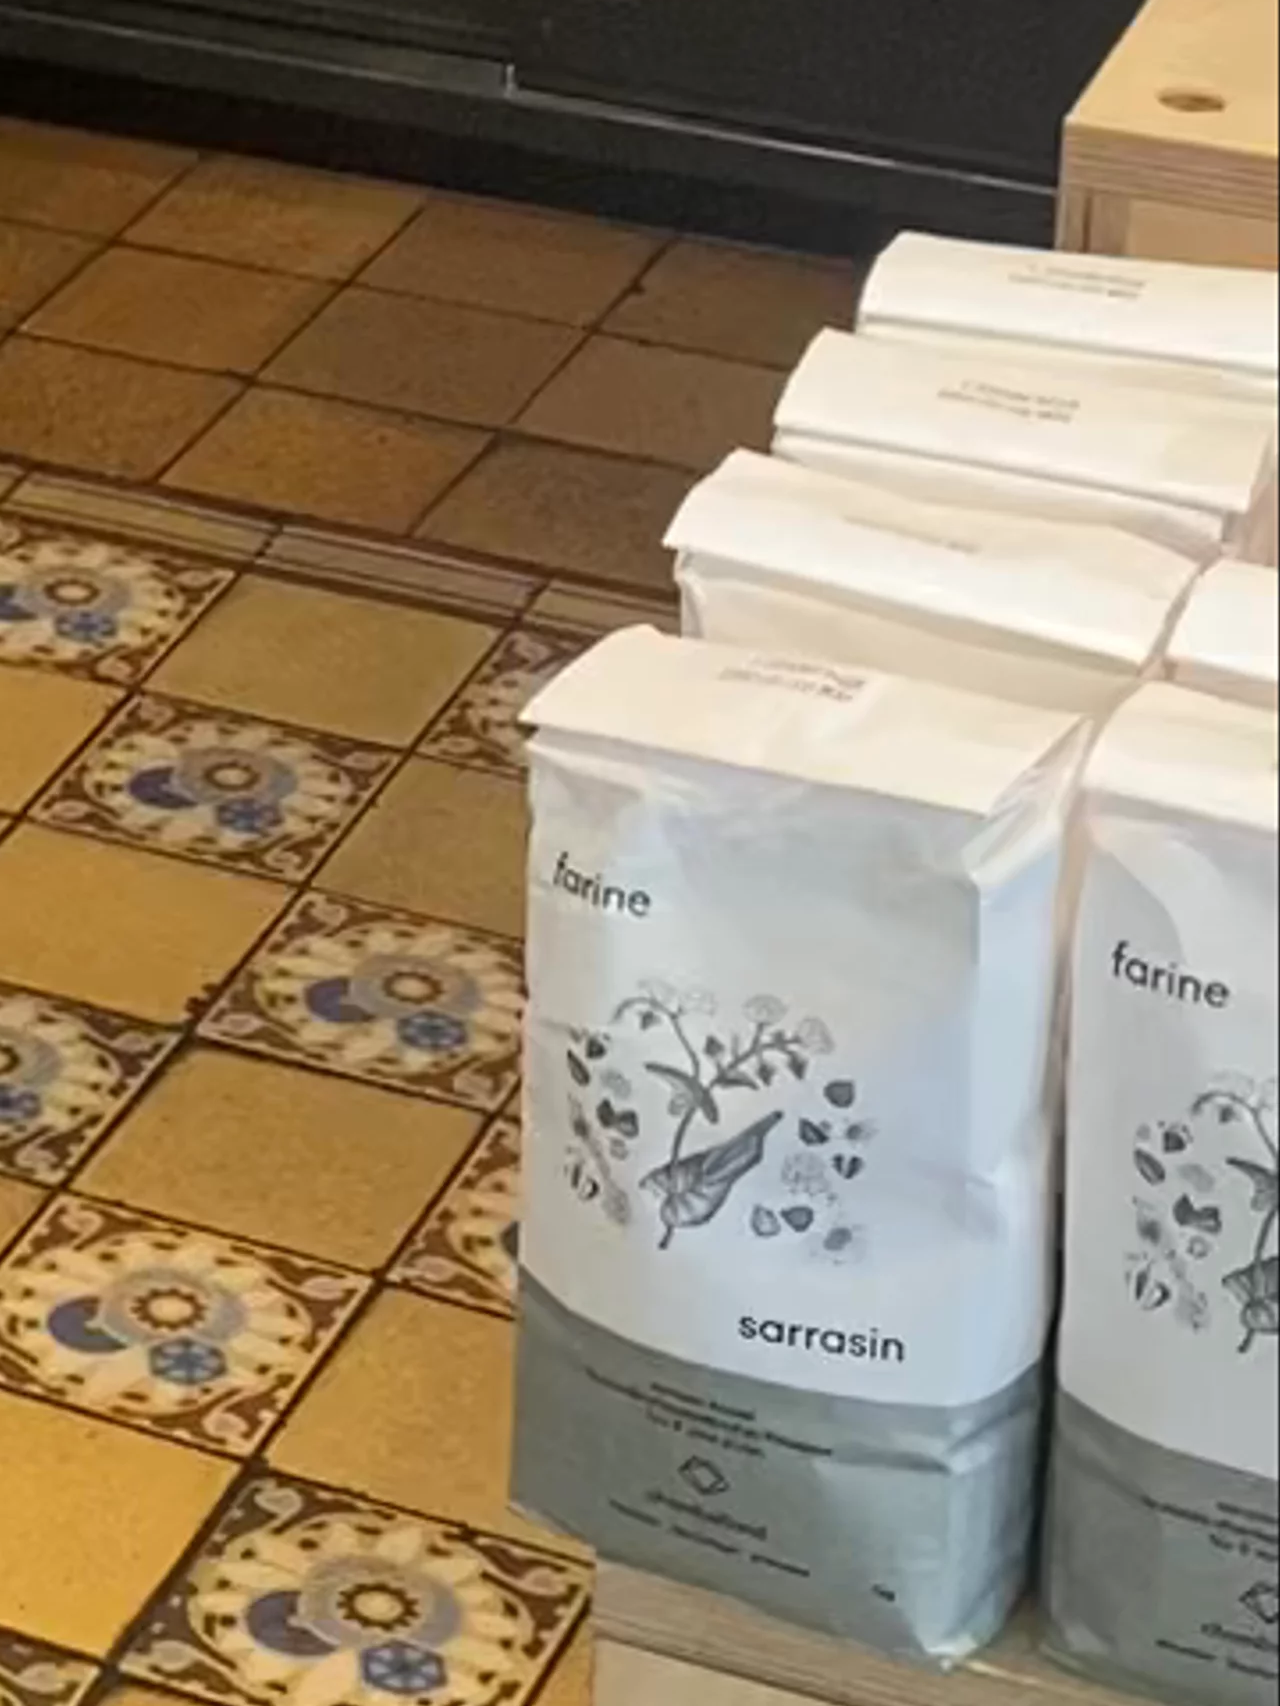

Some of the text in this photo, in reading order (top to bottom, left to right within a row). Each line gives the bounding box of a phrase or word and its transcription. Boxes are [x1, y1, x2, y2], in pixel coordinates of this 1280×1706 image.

[552, 851, 652, 918] farine
[1111, 941, 1231, 1010] farine
[738, 1315, 906, 1363] sarrasin
